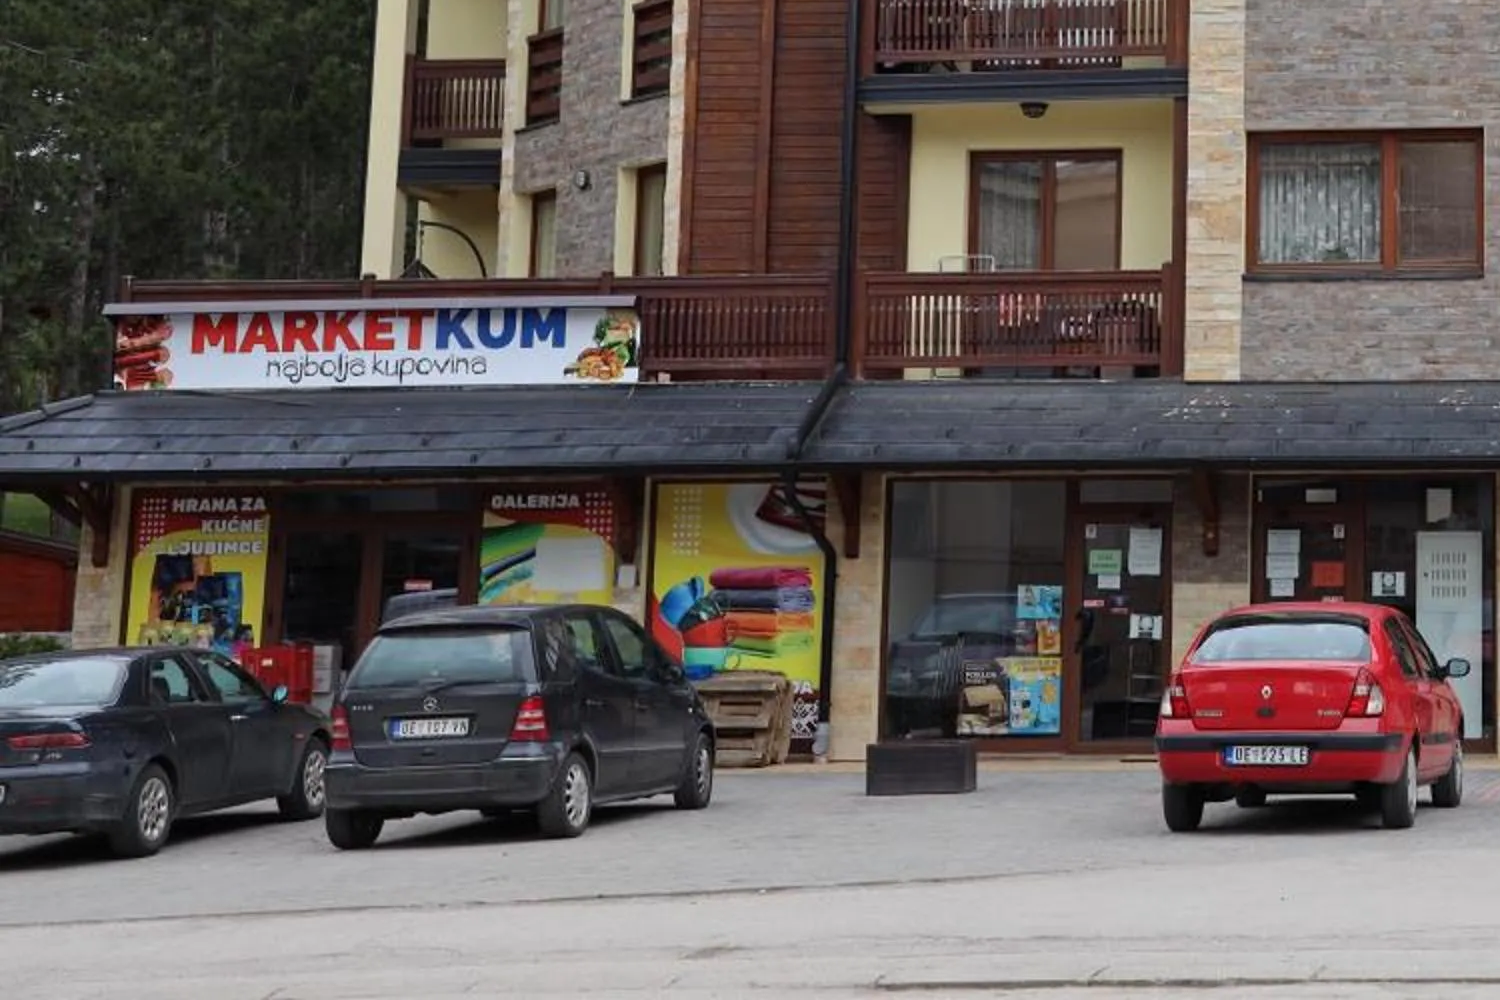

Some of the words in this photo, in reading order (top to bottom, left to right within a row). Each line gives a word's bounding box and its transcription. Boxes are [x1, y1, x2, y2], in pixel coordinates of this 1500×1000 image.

[265, 353, 366, 383] najbolja
[372, 352, 488, 383] kupovina
[172, 497, 238, 512] HRANA
[241, 497, 266, 511] ZA
[491, 494, 580, 509] GALERIJA
[201, 514, 264, 533] KUĆNE
[168, 540, 262, 555] LJUBIMCE
